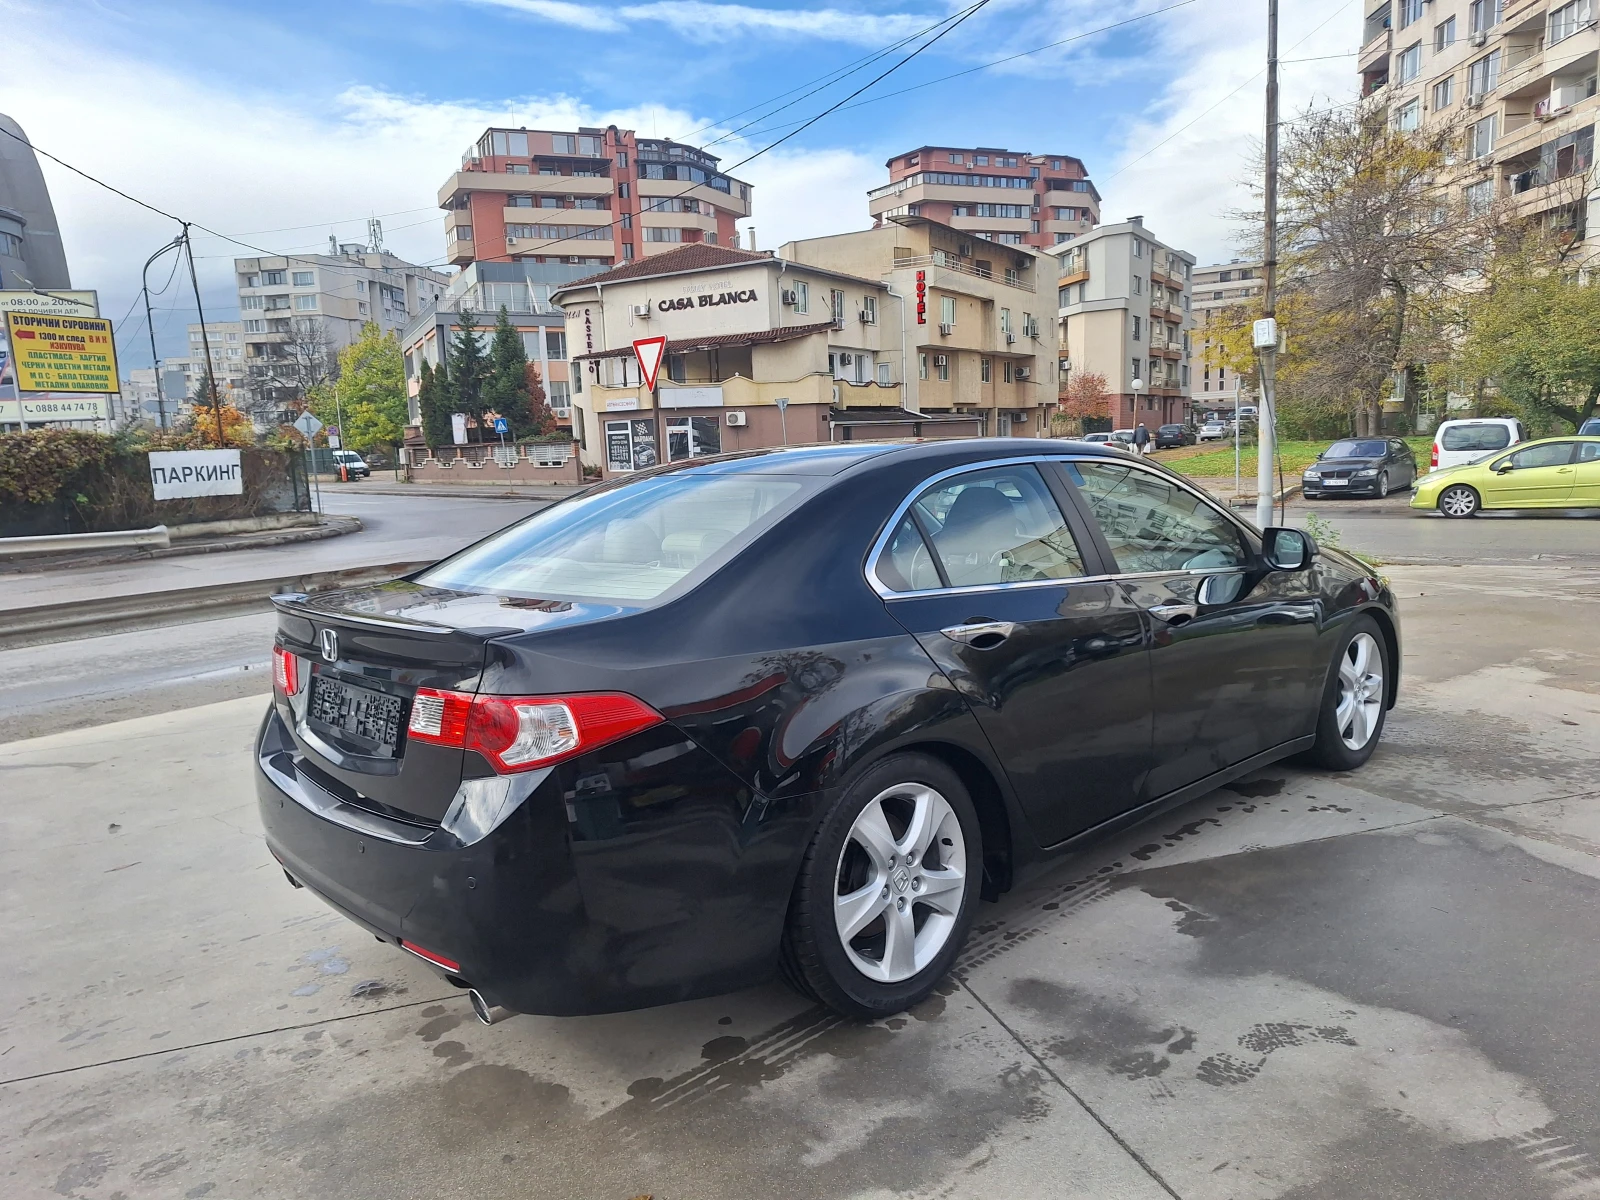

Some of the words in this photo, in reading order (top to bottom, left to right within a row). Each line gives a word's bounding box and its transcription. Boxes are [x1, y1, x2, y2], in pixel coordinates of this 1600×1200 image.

[658, 297, 694, 312] CASA
[698, 289, 758, 308] BLANCA
[916, 270, 926, 324] HOTEL
[13, 315, 61, 328] ВТОРИЧНИ
[62, 319, 107, 331] СУРОВИНИ
[38, 332, 57, 340] 1300
[66, 335, 86, 343] след
[50, 342, 86, 351] ИЗКУПУВА
[28, 351, 74, 360] ПЛАСТМАСА
[79, 354, 107, 362] ХАРТИЯ
[21, 361, 46, 369] ЧЕРНИ
[54, 362, 82, 371] ЦВЕТНИ
[83, 363, 112, 371] МЕТАЛИ
[57, 372, 78, 380] БЯЛА
[79, 373, 109, 381] ТЕХНИКА
[35, 380, 70, 388] МЕТАЛНИ
[72, 381, 109, 389] ОПАКОВКИ
[35, 404, 59, 413] 0888
[60, 403, 72, 411] 44
[74, 402, 85, 411] 74
[86, 402, 98, 410] 78
[152, 464, 239, 484] ПАРКИНГ
